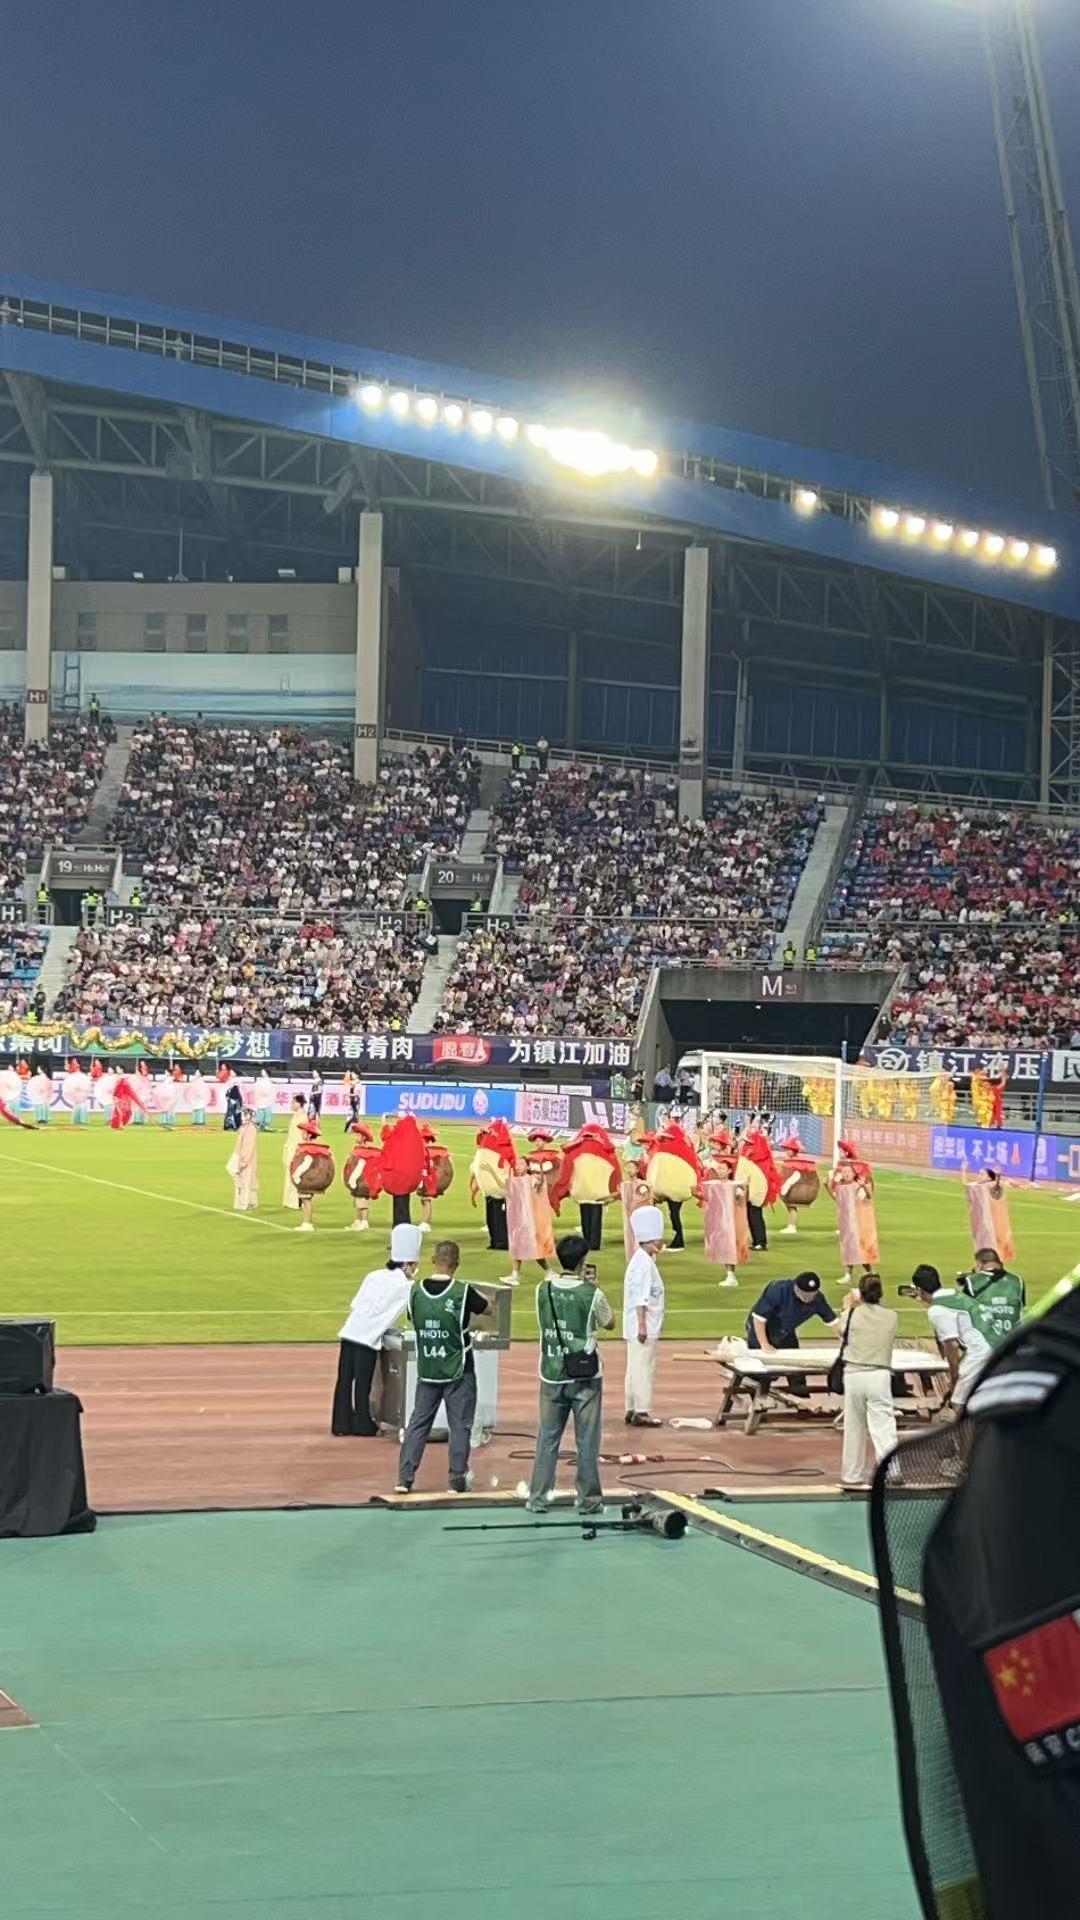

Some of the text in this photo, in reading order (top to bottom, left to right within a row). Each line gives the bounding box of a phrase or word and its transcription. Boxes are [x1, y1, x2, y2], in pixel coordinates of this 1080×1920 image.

[358, 725, 375, 737] H2
[57, 860, 73, 873] 19
[438, 870, 455, 884] 20
[1, 905, 23, 921] H1
[110, 909, 134, 925] H2
[762, 975, 783, 996] M
[292, 1034, 414, 1060] 品源春肴肉
[508, 1038, 631, 1066] 为镇江加油
[916, 1050, 1041, 1079] 镇江液压
[398, 1091, 466, 1111] SUDUDU
[419, 1328, 450, 1339] PHOTO
[544, 1328, 575, 1341] PHTO
[423, 1344, 447, 1358] L44
